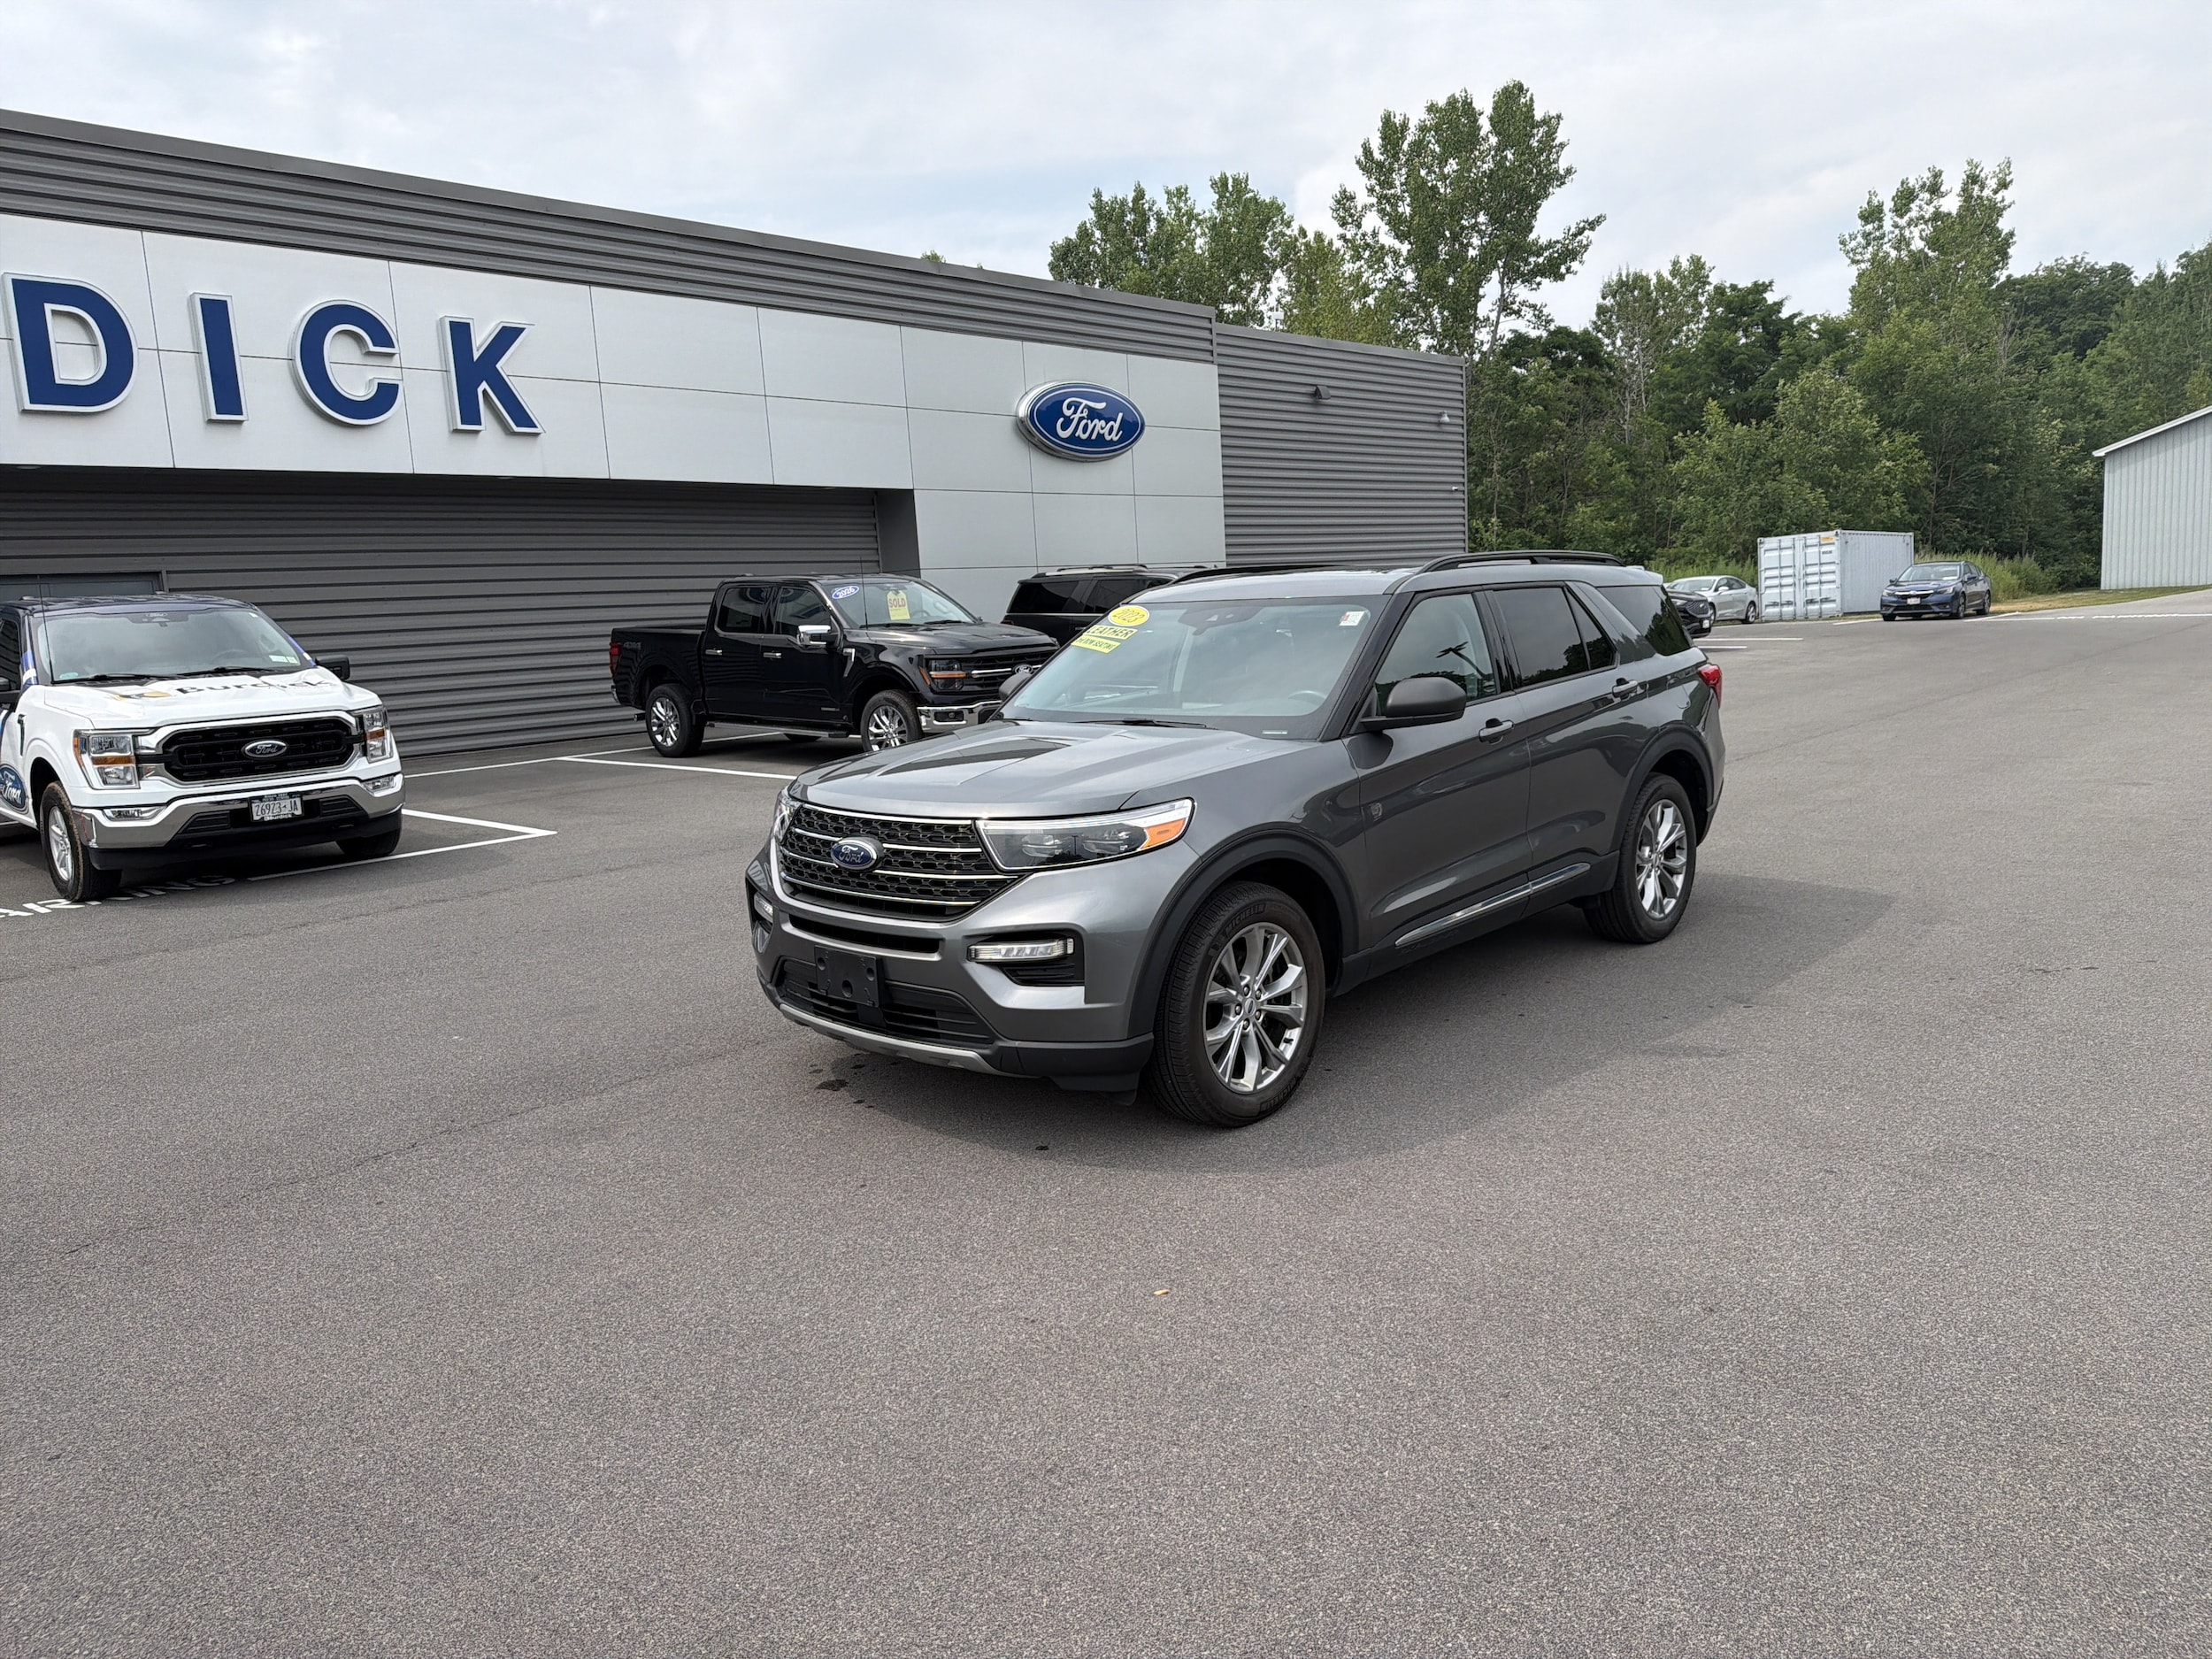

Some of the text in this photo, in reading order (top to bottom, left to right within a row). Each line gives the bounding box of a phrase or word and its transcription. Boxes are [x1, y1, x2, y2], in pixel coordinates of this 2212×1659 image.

[4, 273, 545, 434] DICK
[1056, 397, 1124, 442] Ford
[836, 588, 856, 597] 2026
[888, 597, 906, 608] SOLD
[1111, 609, 1146, 623] 2023
[1087, 625, 1134, 638] LEATHER
[256, 744, 278, 754] Ford
[839, 845, 864, 863] Ford
